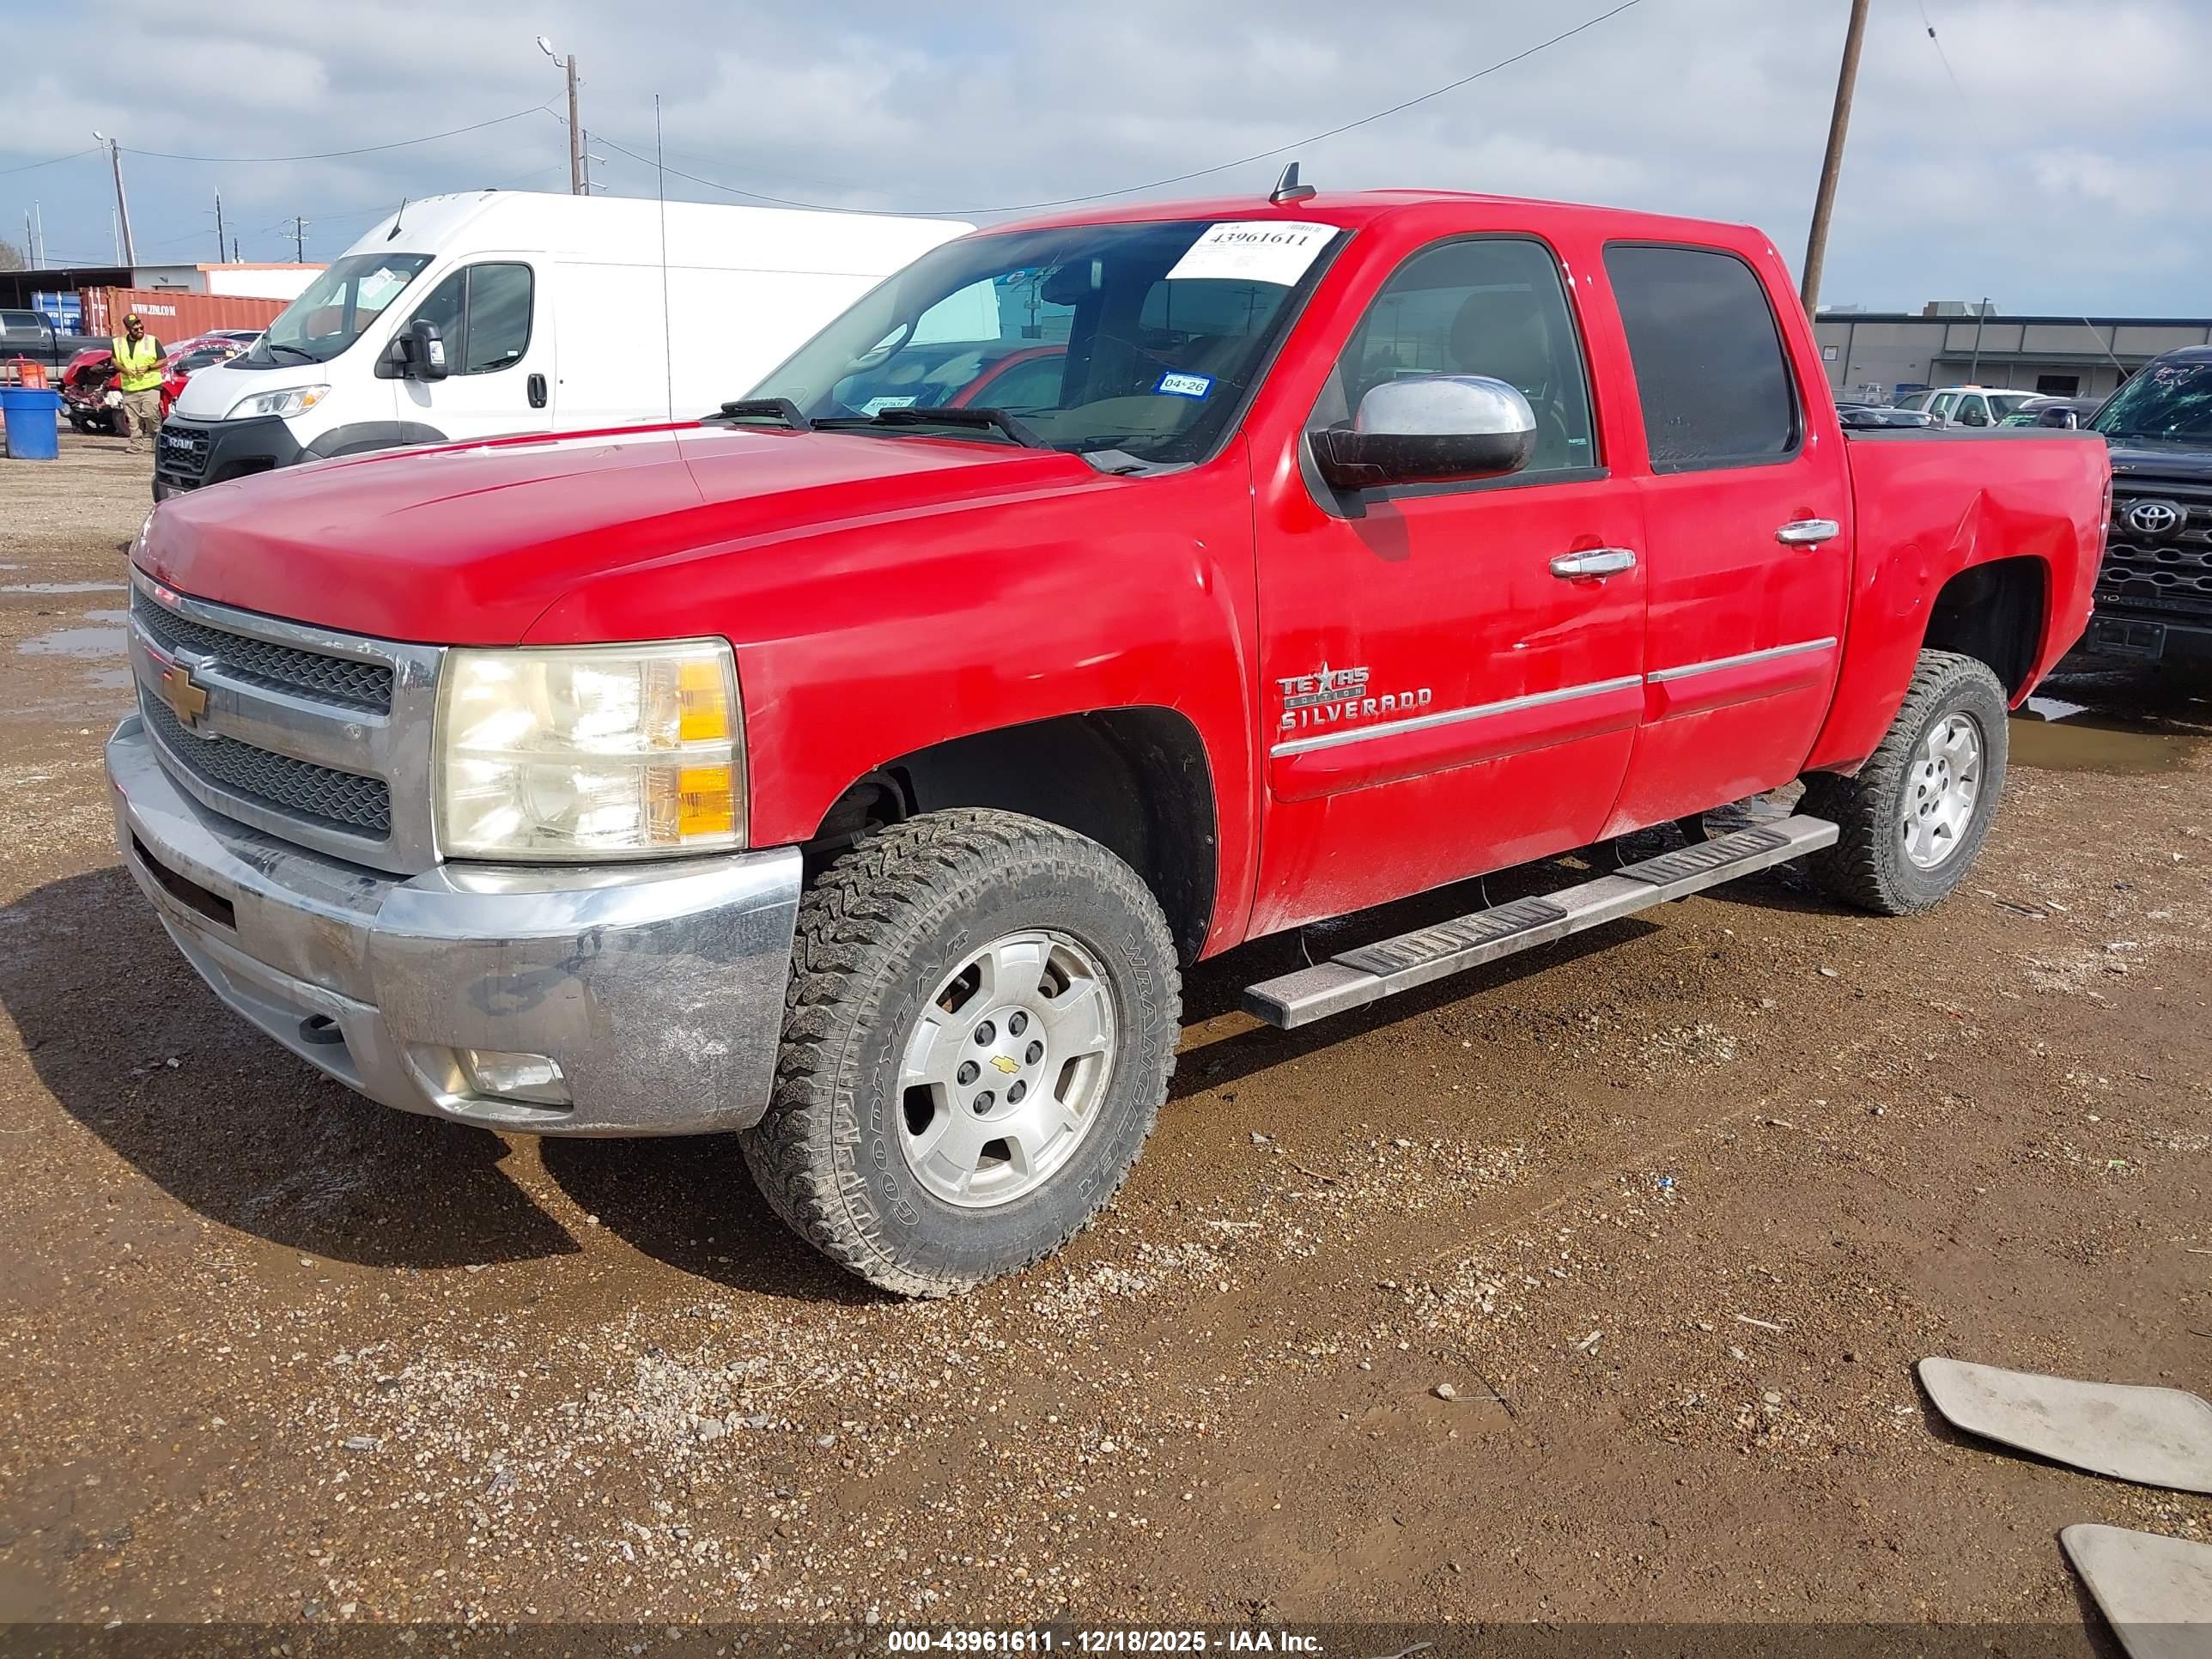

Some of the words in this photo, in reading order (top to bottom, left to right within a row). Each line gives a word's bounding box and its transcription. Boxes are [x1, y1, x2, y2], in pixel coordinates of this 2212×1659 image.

[1211, 233, 1309, 246] 43961611
[1164, 379, 1182, 388] 04
[1187, 381, 1205, 392] 26
[169, 437, 194, 450] RAM
[1276, 662, 1369, 695] TEXAS
[1281, 688, 1432, 730] SILVERADO
[1288, 687, 1364, 708] EDITION
[870, 929, 969, 1225] GOODYEAR
[1077, 933, 1158, 1200] WRANGLER
